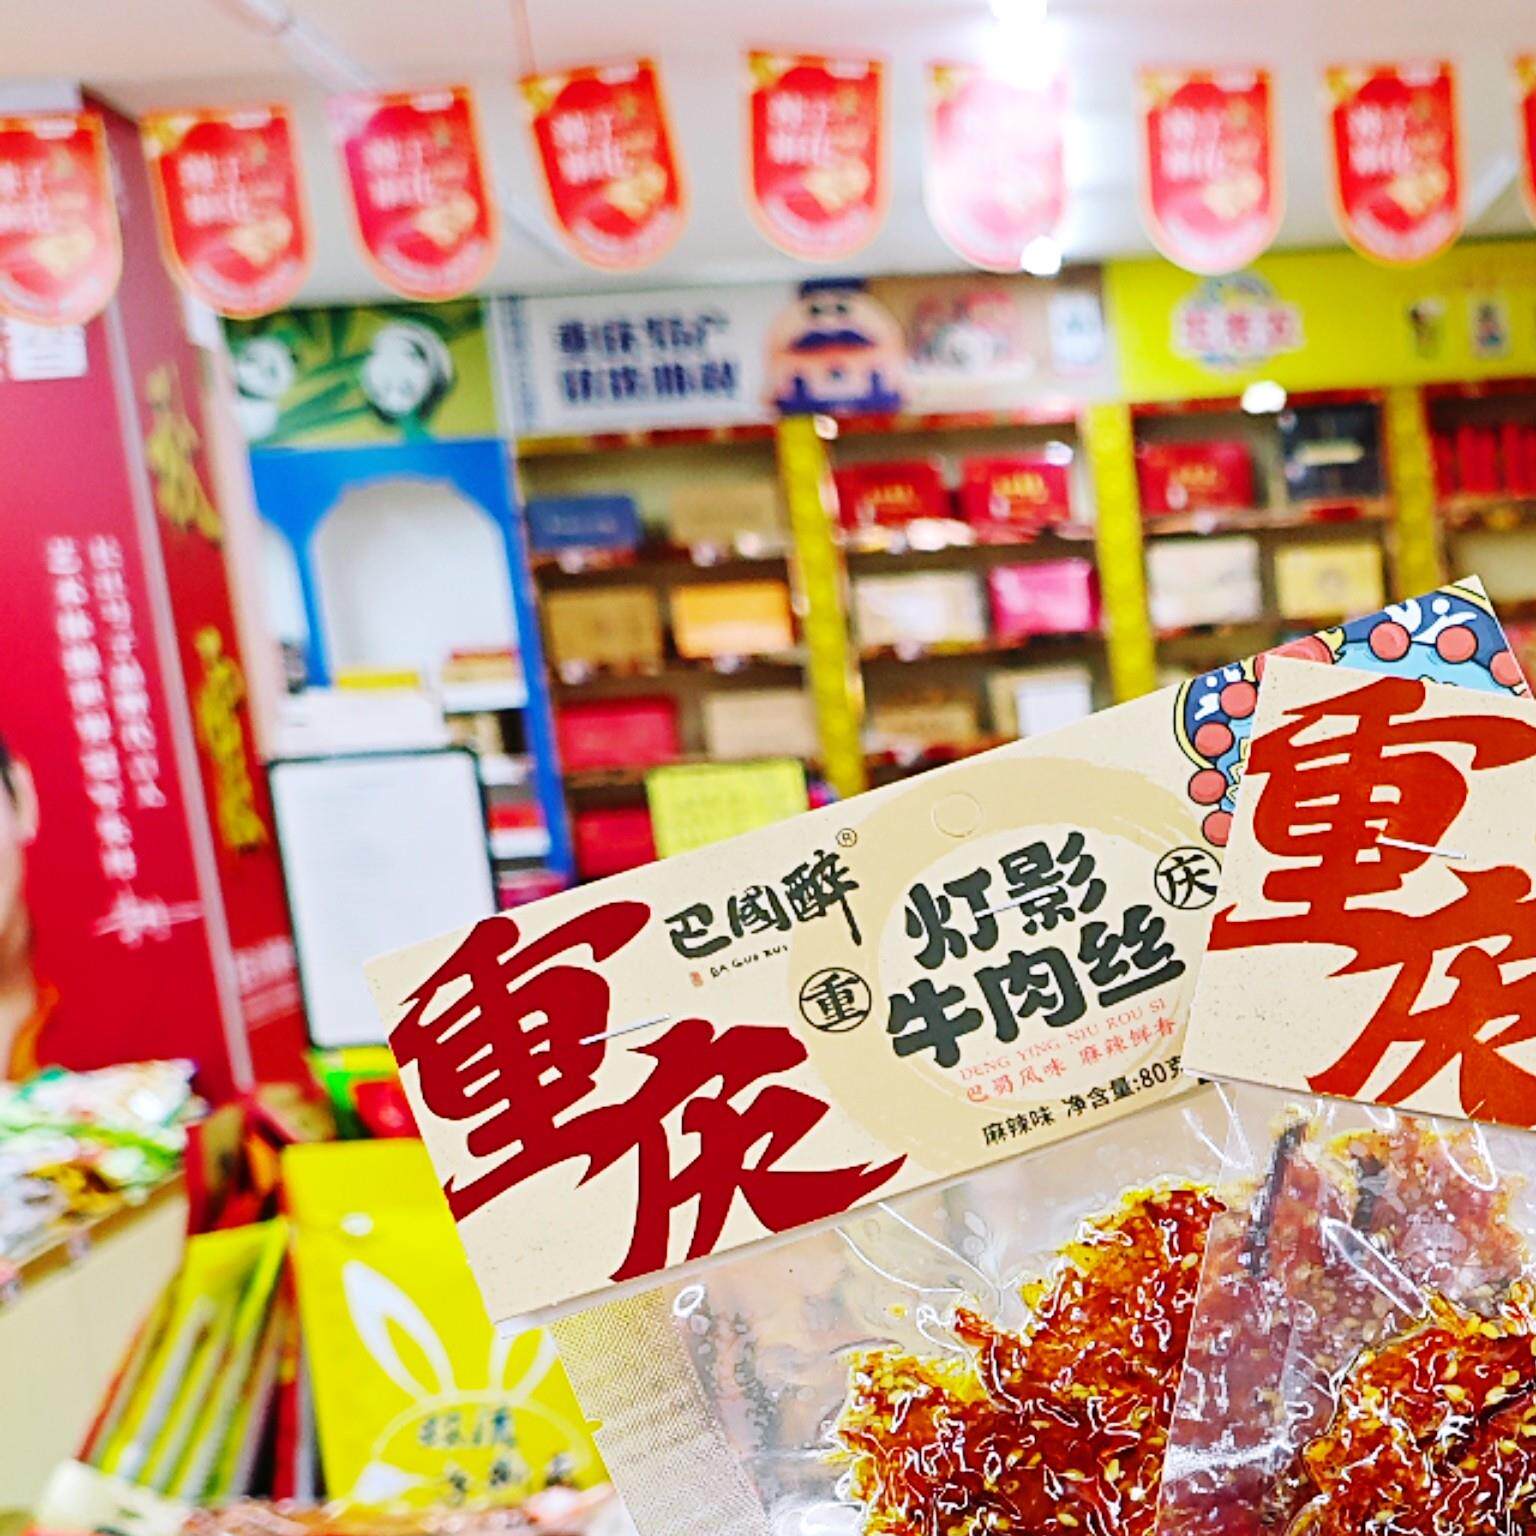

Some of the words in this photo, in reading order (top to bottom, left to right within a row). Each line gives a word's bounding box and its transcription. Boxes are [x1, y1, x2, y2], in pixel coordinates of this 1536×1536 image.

[905, 831, 1107, 970] 灯影
[1155, 848, 1220, 909] 庆
[800, 968, 871, 1032] 重
[886, 904, 1187, 1068] 牛肉丝
[959, 1057, 1011, 1081] DENG
[1018, 1039, 1061, 1060] YING
[1066, 1025, 1100, 1044] NIU
[1106, 1007, 1144, 1029] ROU
[1150, 998, 1166, 1013] SI
[389, 901, 907, 1282] 重庆
[967, 1058, 1067, 1103] 巴蜀风味
[982, 1106, 1056, 1146] 麻辣味
